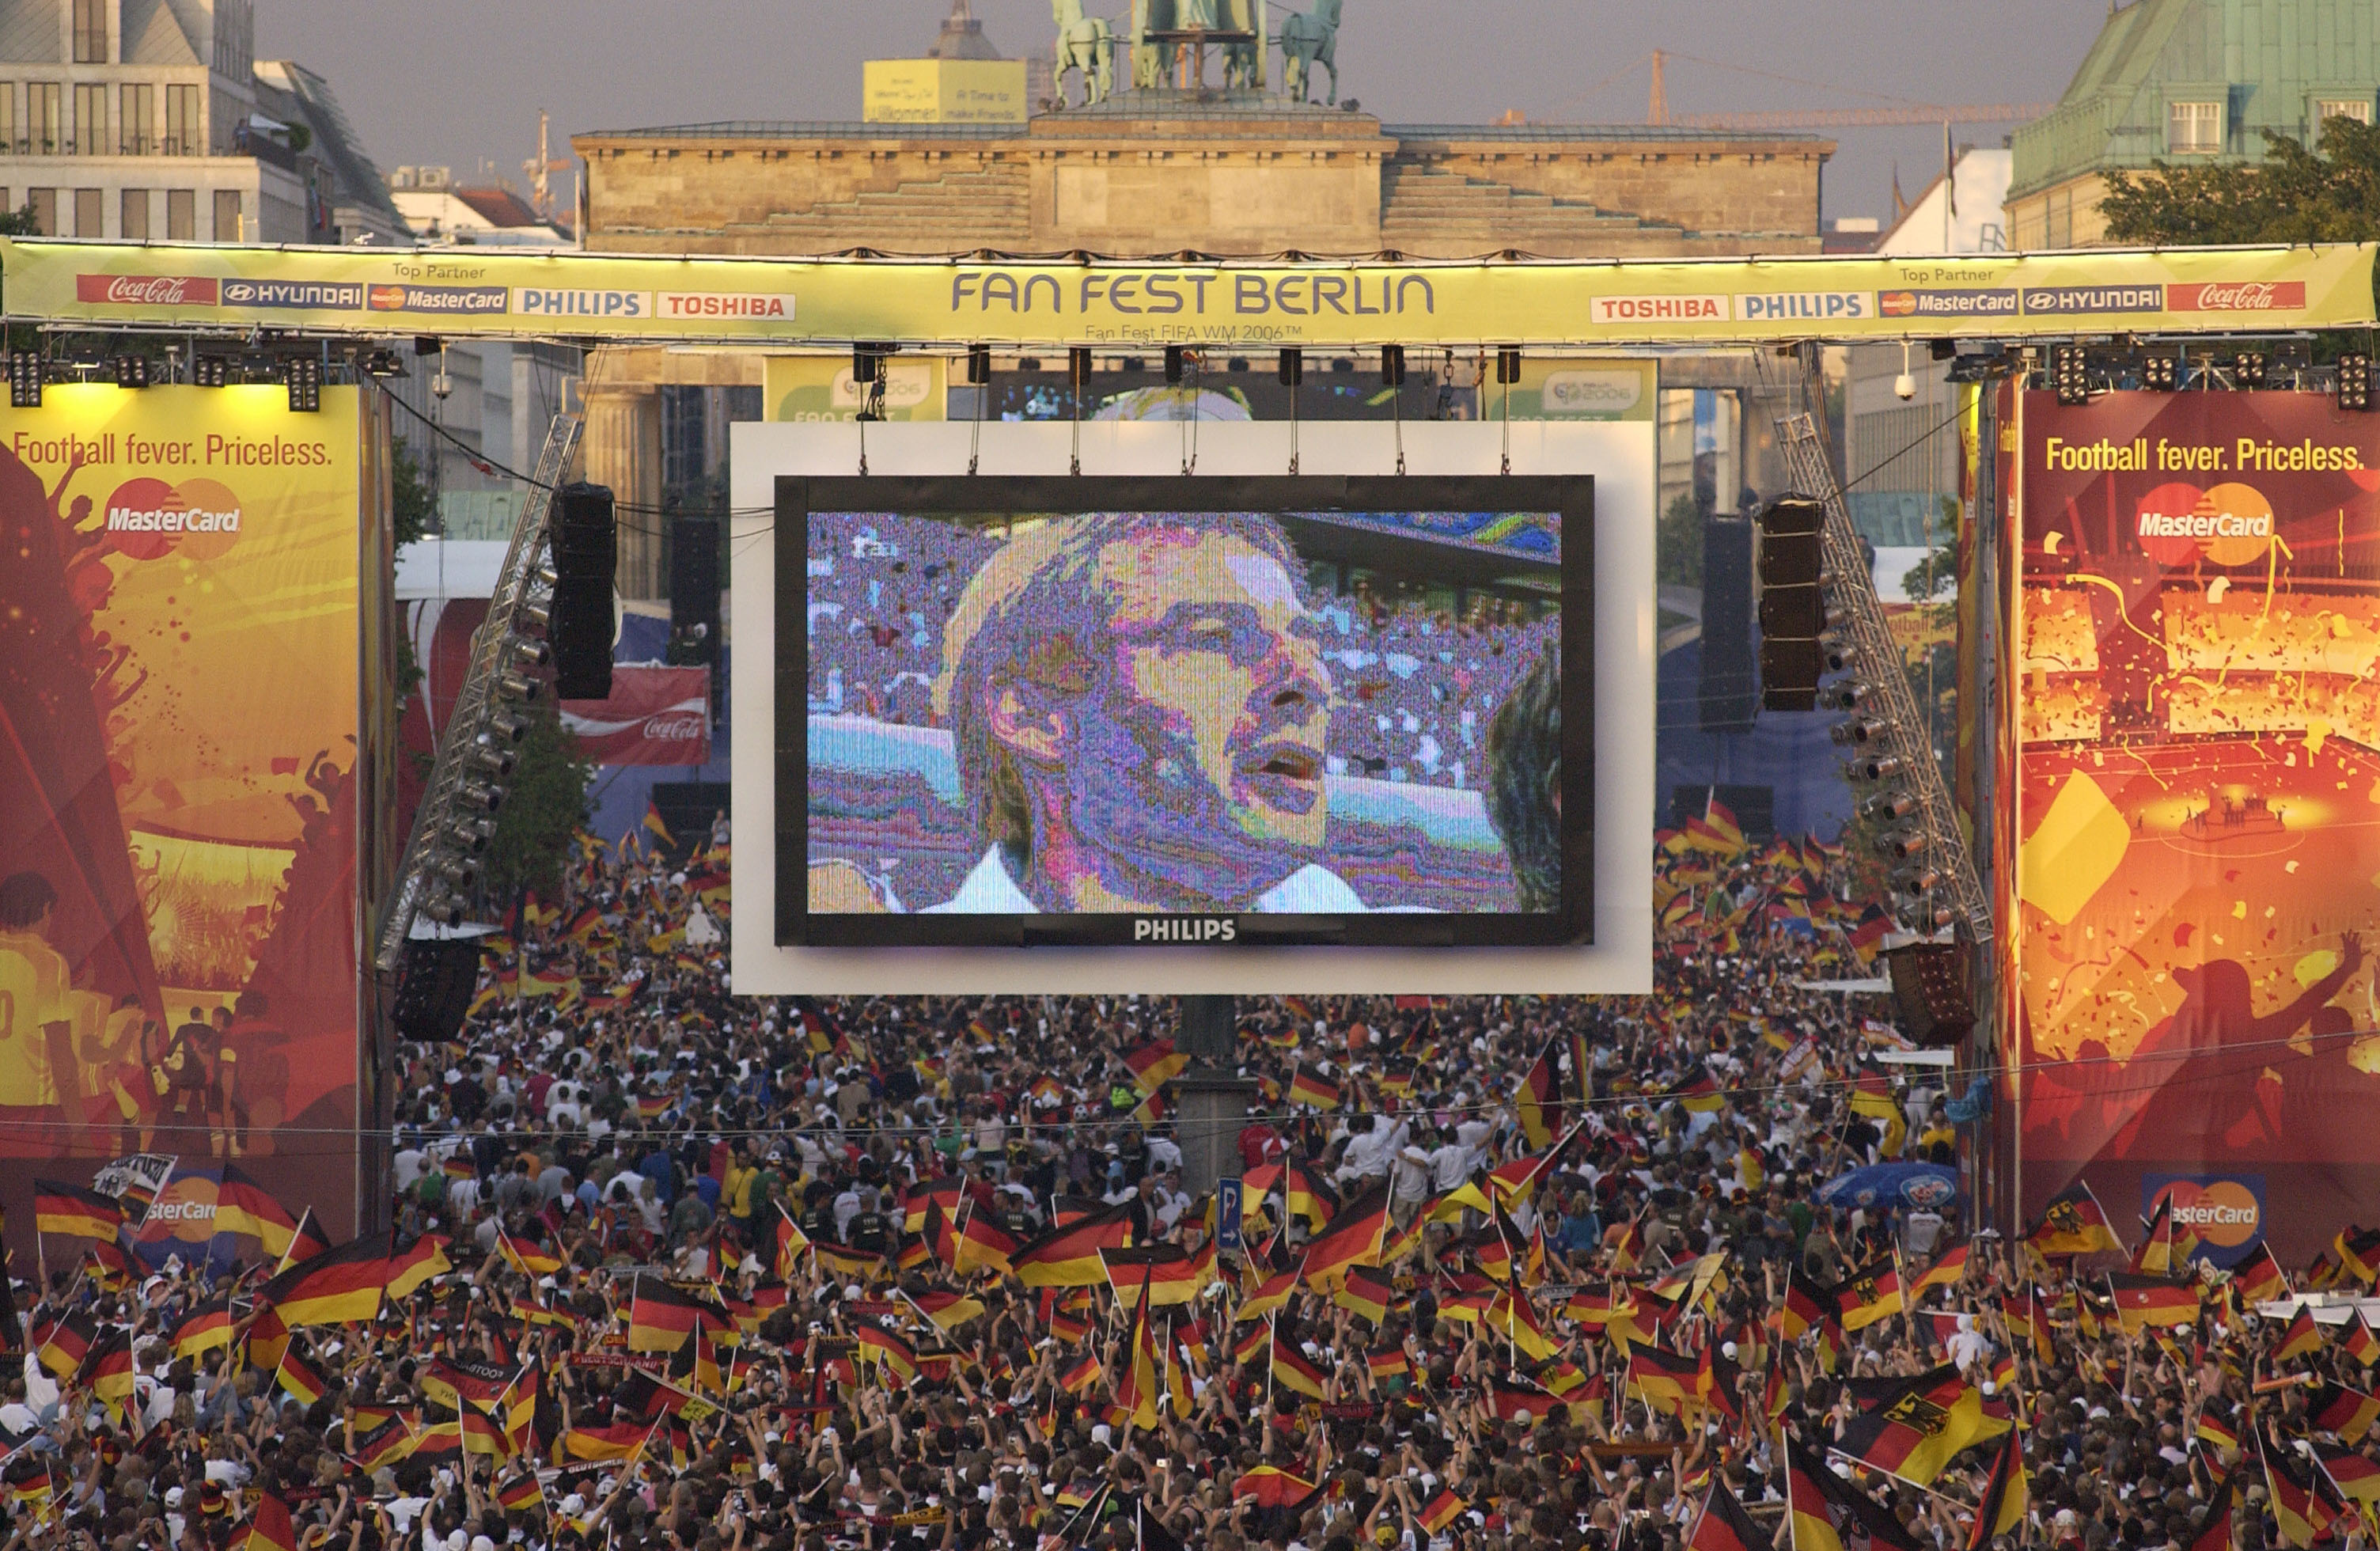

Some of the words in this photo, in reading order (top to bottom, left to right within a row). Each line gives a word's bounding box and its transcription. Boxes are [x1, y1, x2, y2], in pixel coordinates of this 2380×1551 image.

[392, 263, 420, 280] Top
[426, 264, 487, 279] Partner
[1901, 267, 1929, 284] Top
[1935, 267, 1994, 282] Partner
[108, 276, 188, 304] Coca-Cola
[259, 284, 362, 305] HYUNDAI
[407, 290, 506, 309] MasterCard
[952, 272, 1061, 313] FAN
[1081, 274, 1218, 314] FEST
[1235, 274, 1434, 316] BERLIN
[2059, 290, 2161, 309] HYUNDAI
[2197, 283, 2277, 309] Coca-Cola
[523, 290, 640, 317] PHILIPS
[668, 296, 785, 317] TOSHIBA
[1601, 299, 1719, 319] TOSHIBA
[1745, 294, 1862, 318] PHILIPS
[1919, 293, 2016, 313] MasterCard
[1085, 325, 1115, 339] Fan
[1121, 324, 1156, 339] Fest
[1161, 324, 1198, 339] FIFA
[1203, 325, 1237, 340] WM
[13, 431, 116, 465] Football
[125, 433, 197, 466] fever.
[206, 433, 332, 467] Priceless.
[2046, 438, 2147, 471] Football
[2157, 437, 2228, 472] fever.
[2237, 437, 2365, 472] Priceless.
[108, 506, 241, 532] MasterCard
[2138, 513, 2271, 537] MasterCard
[1134, 919, 1236, 941] PHILIPS
[148, 1200, 216, 1220] sterCar
